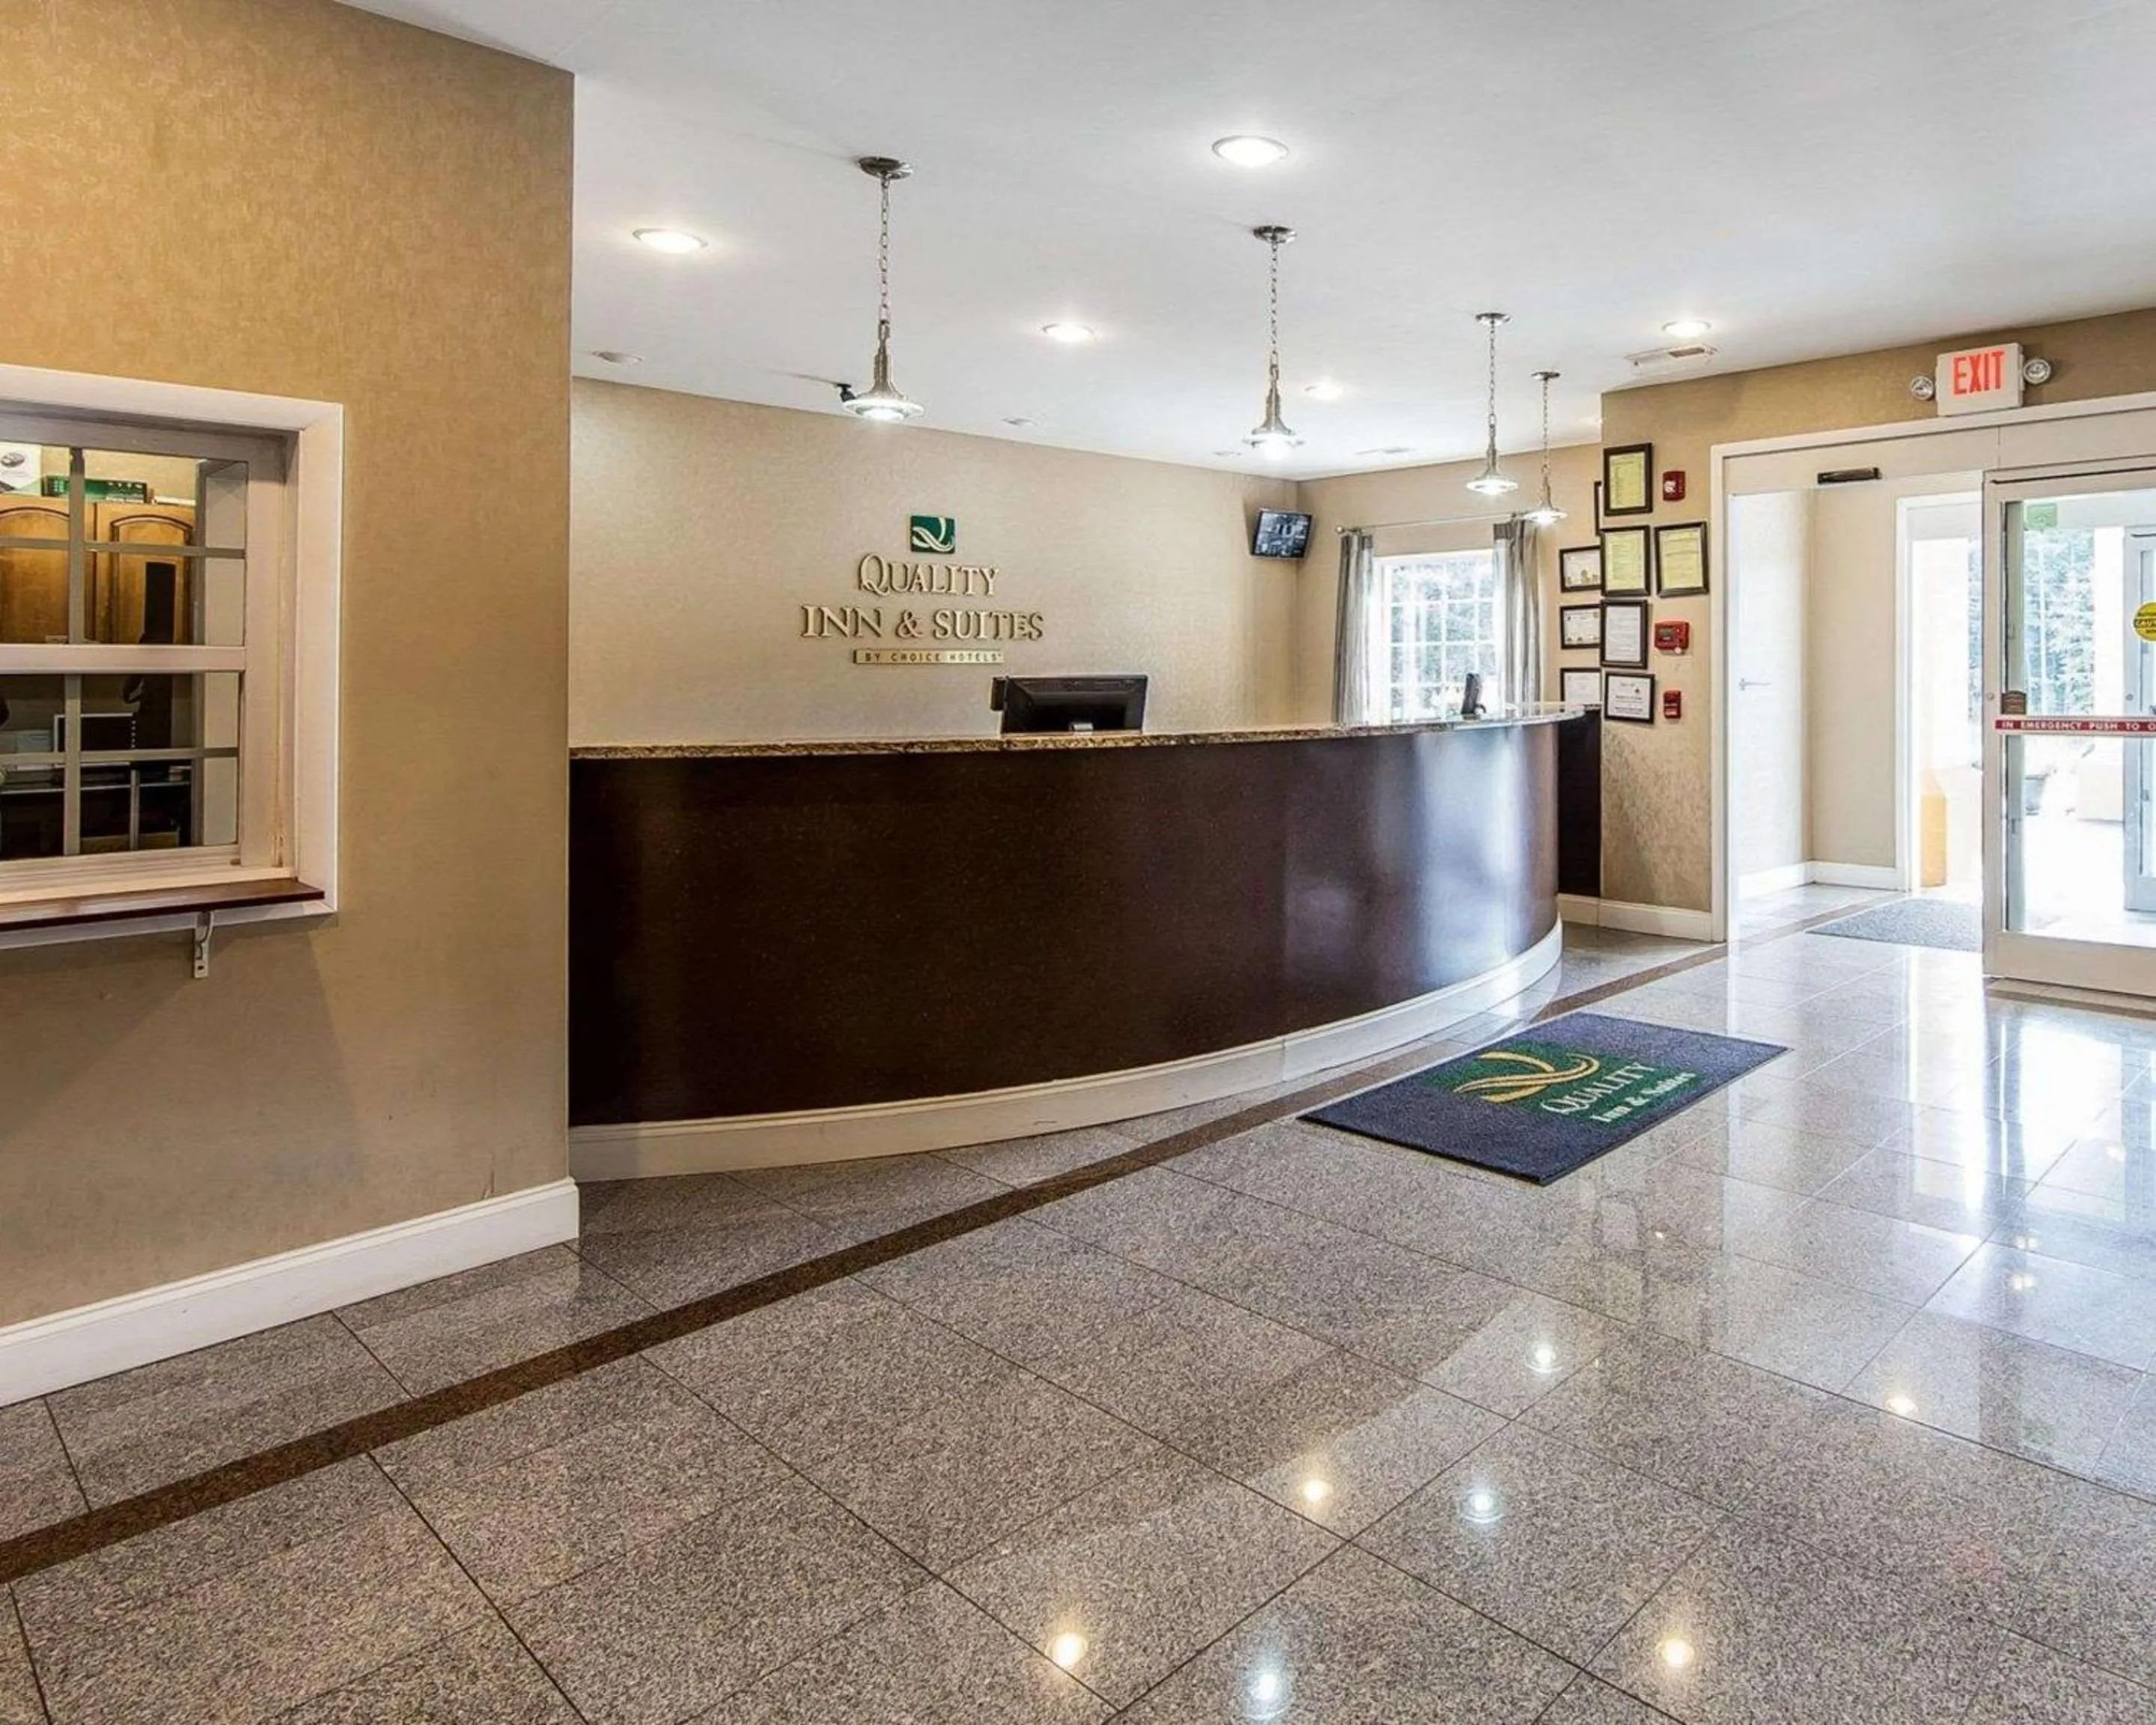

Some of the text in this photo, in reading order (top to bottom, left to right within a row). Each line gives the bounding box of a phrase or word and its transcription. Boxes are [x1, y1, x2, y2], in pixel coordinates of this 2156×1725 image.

[1953, 351, 2005, 395] EXIT
[859, 552, 999, 597] QUALITY
[801, 604, 1045, 642] INN & SUITES
[865, 652, 998, 663] BY CHOICE HOTELS
[2002, 720, 2014, 729] IN
[2021, 720, 2081, 730] EMERGENCY
[2089, 721, 2118, 731] PUSH
[2126, 722, 2140, 731] TO
[1540, 1062, 1656, 1115] QUALITY
[1624, 1095, 1651, 1107] &
